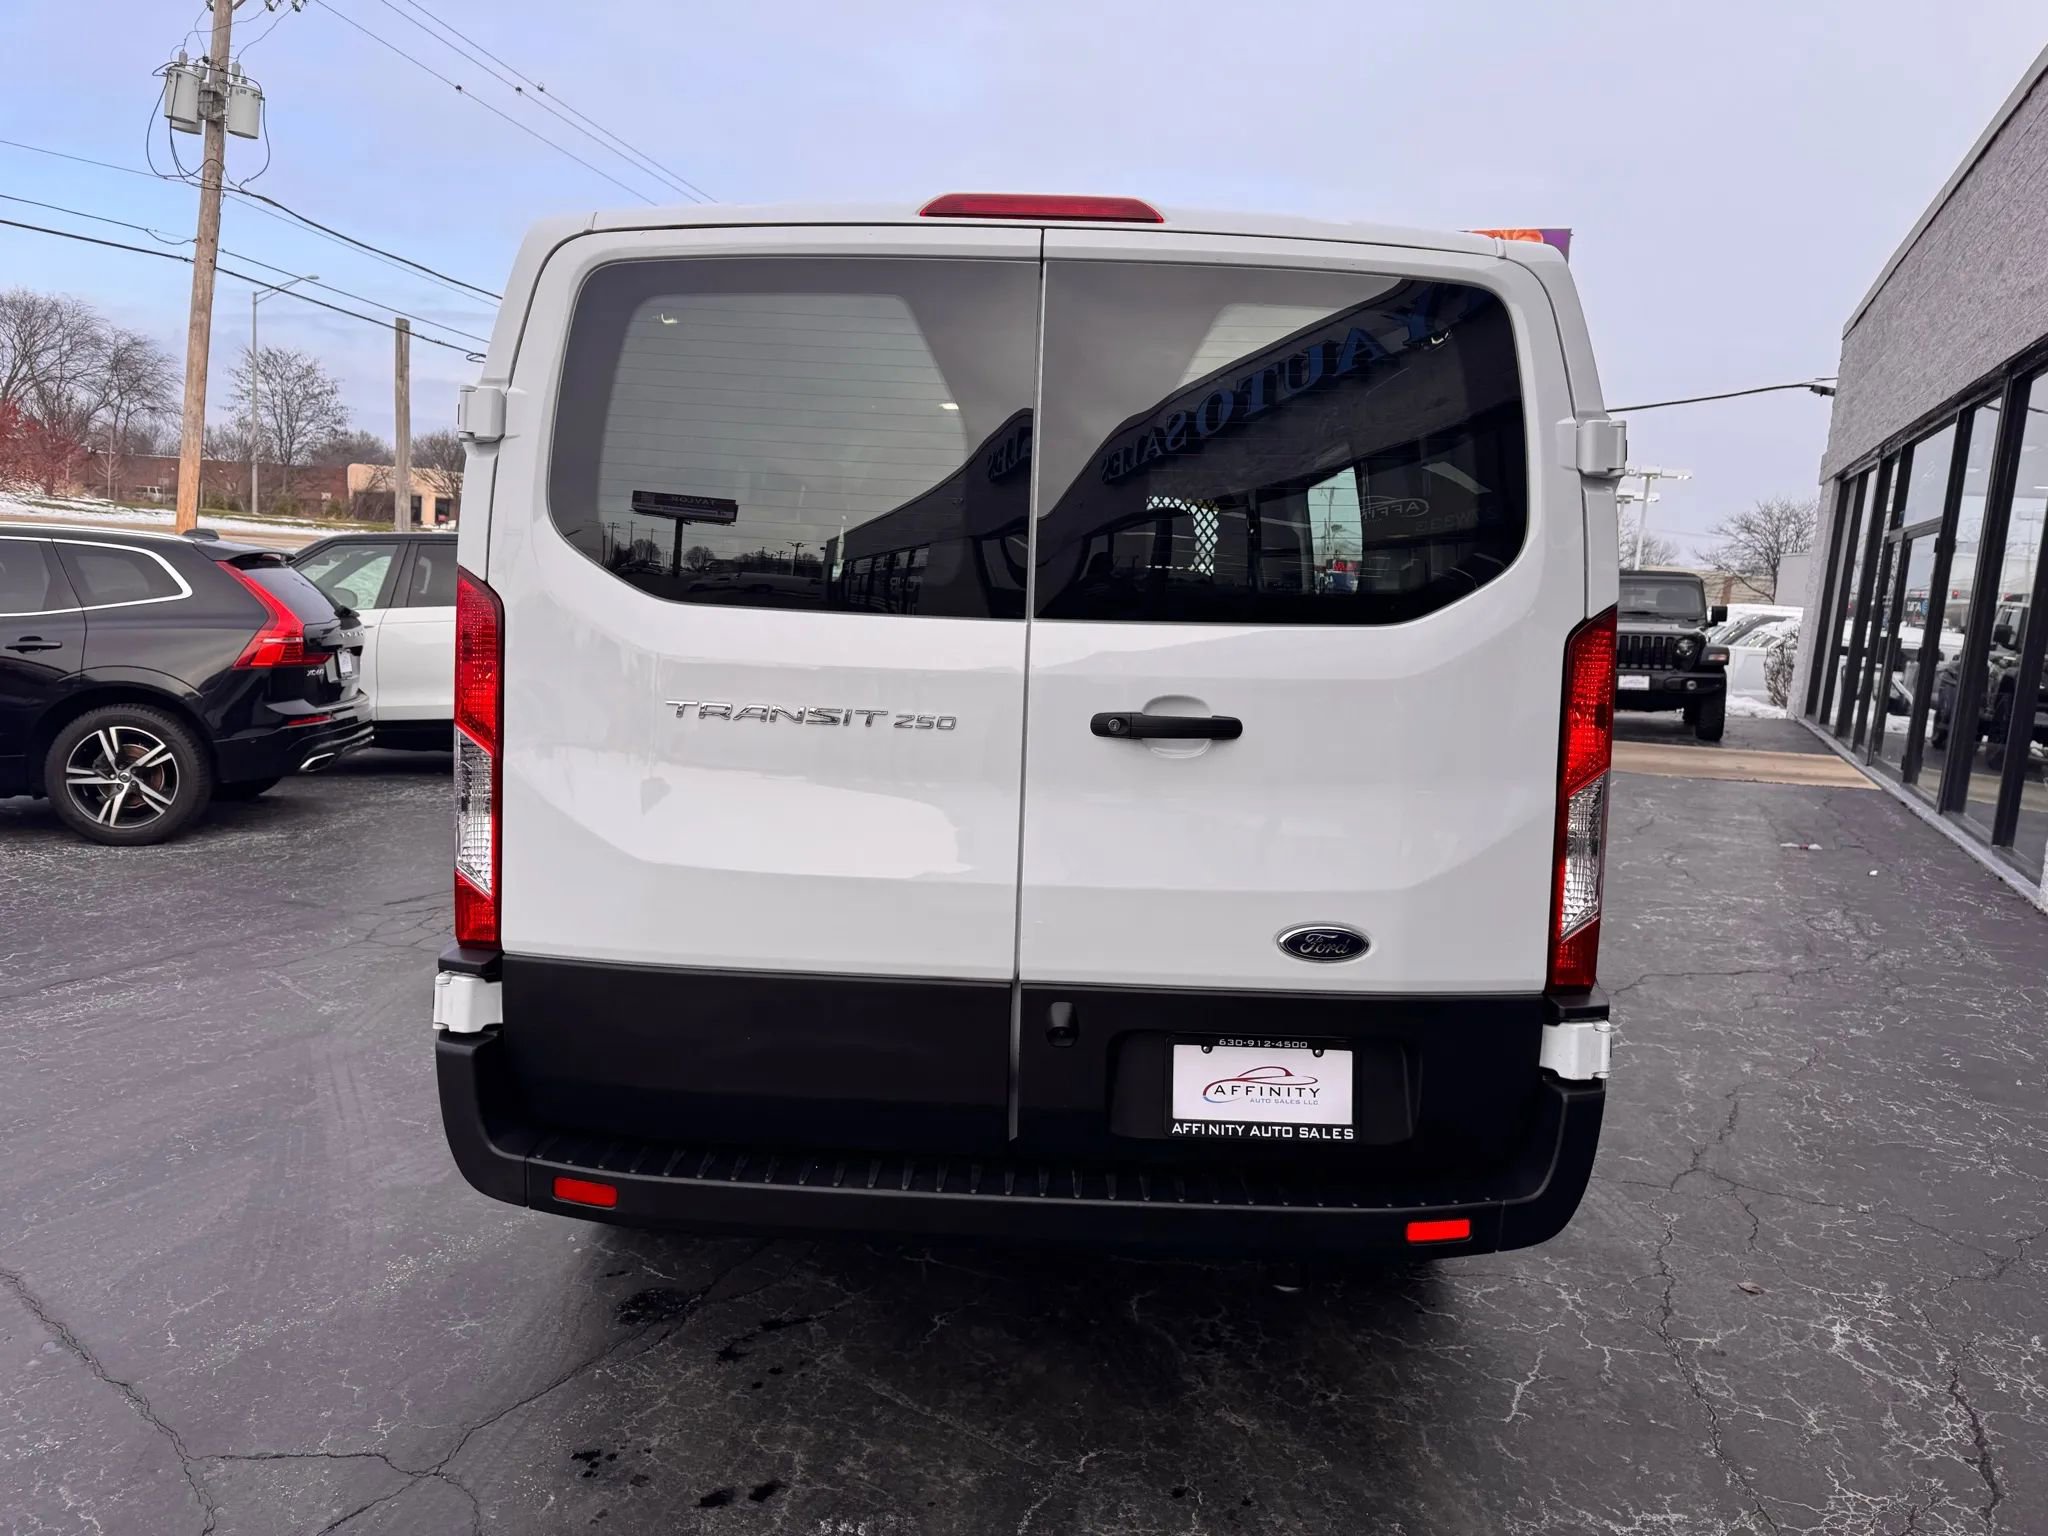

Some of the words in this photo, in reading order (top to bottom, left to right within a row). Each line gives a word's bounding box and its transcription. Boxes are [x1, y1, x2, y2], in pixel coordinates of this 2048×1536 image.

[665, 699, 888, 728] TRANSIT
[893, 714, 957, 730] 250
[1300, 933, 1350, 954] Ford
[1213, 1084, 1321, 1099] AFFINITY
[1172, 1122, 1246, 1136] AFFINITY
[1250, 1125, 1293, 1138] AUTO
[1299, 1126, 1354, 1140] SALES
